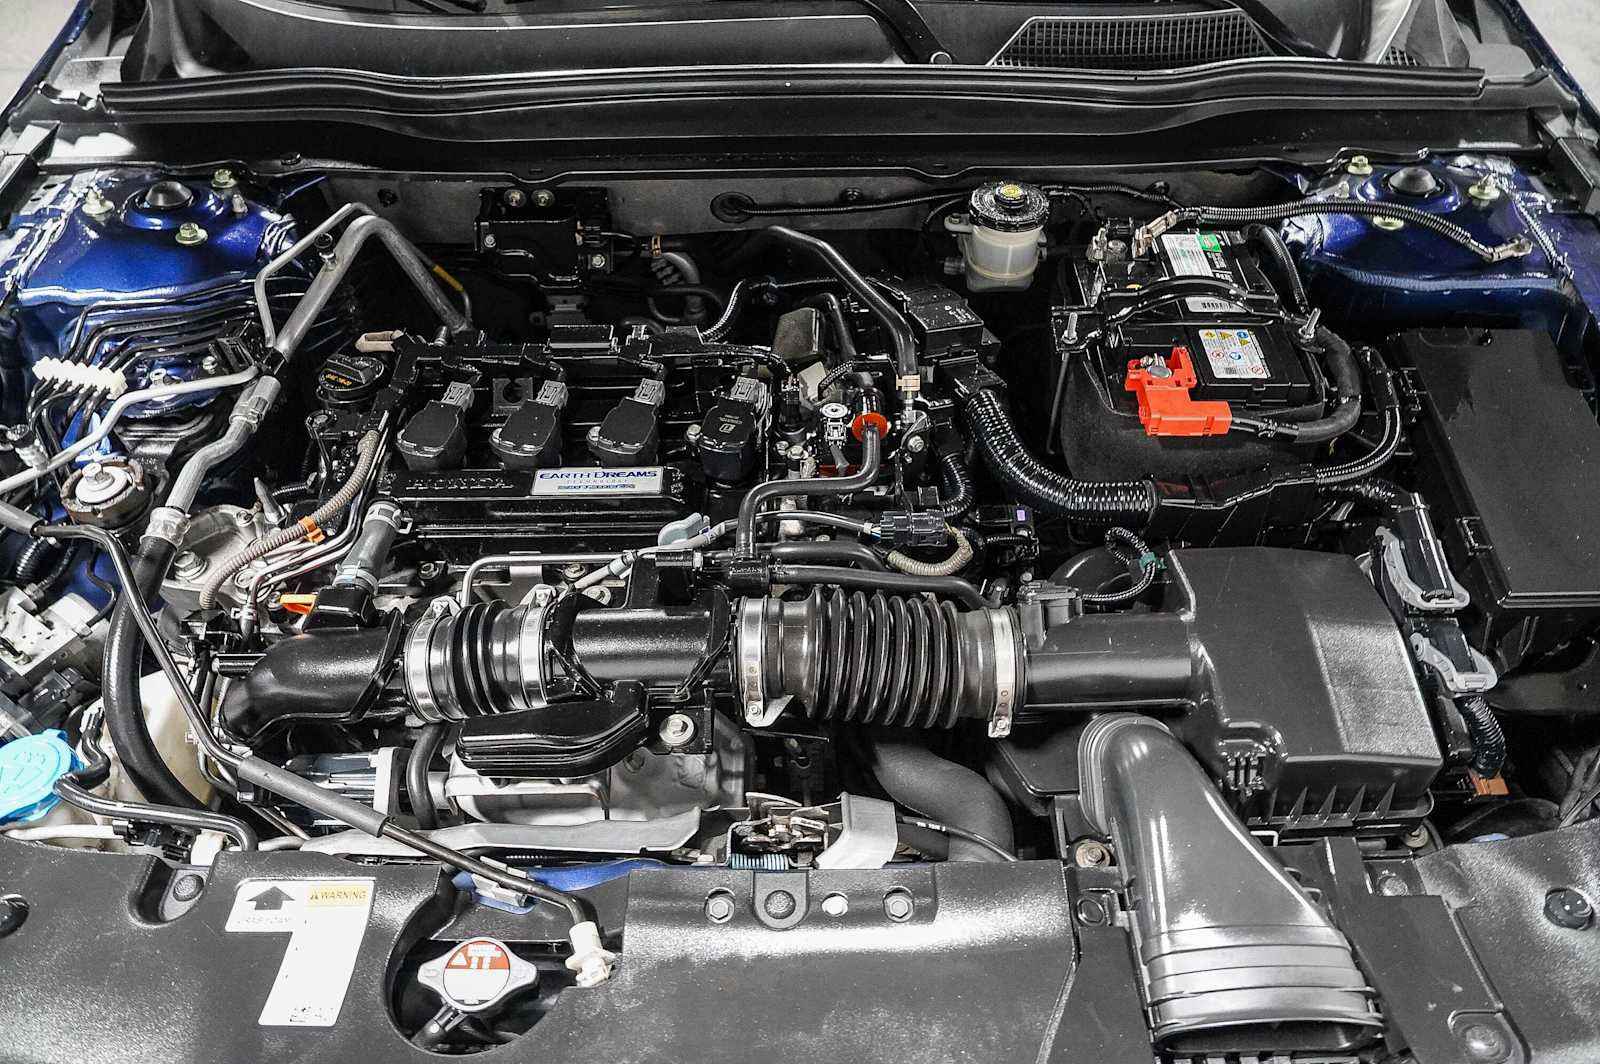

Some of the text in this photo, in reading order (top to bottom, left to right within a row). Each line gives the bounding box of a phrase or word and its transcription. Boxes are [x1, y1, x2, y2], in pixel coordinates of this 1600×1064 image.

[539, 470, 658, 480] EARTH DREAMS
[405, 477, 515, 490] HONDA
[320, 890, 367, 899] WARNING
